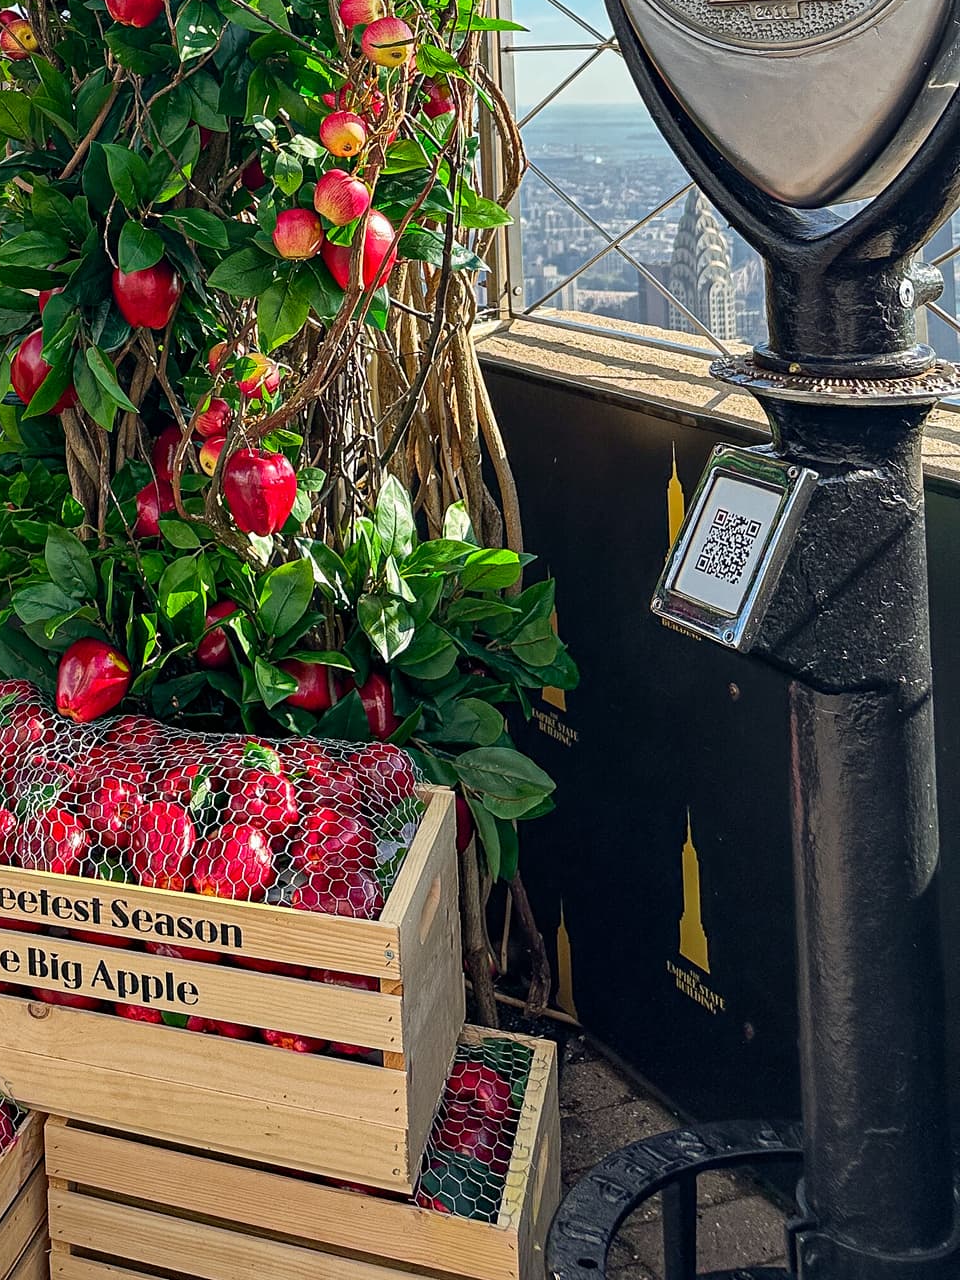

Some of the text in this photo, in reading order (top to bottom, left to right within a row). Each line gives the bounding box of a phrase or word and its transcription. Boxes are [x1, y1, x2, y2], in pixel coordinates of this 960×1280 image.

[755, 4, 790, 19] 2411
[111, 899, 243, 948] Season
[28, 947, 82, 990] Big
[91, 959, 199, 1006] Apple
